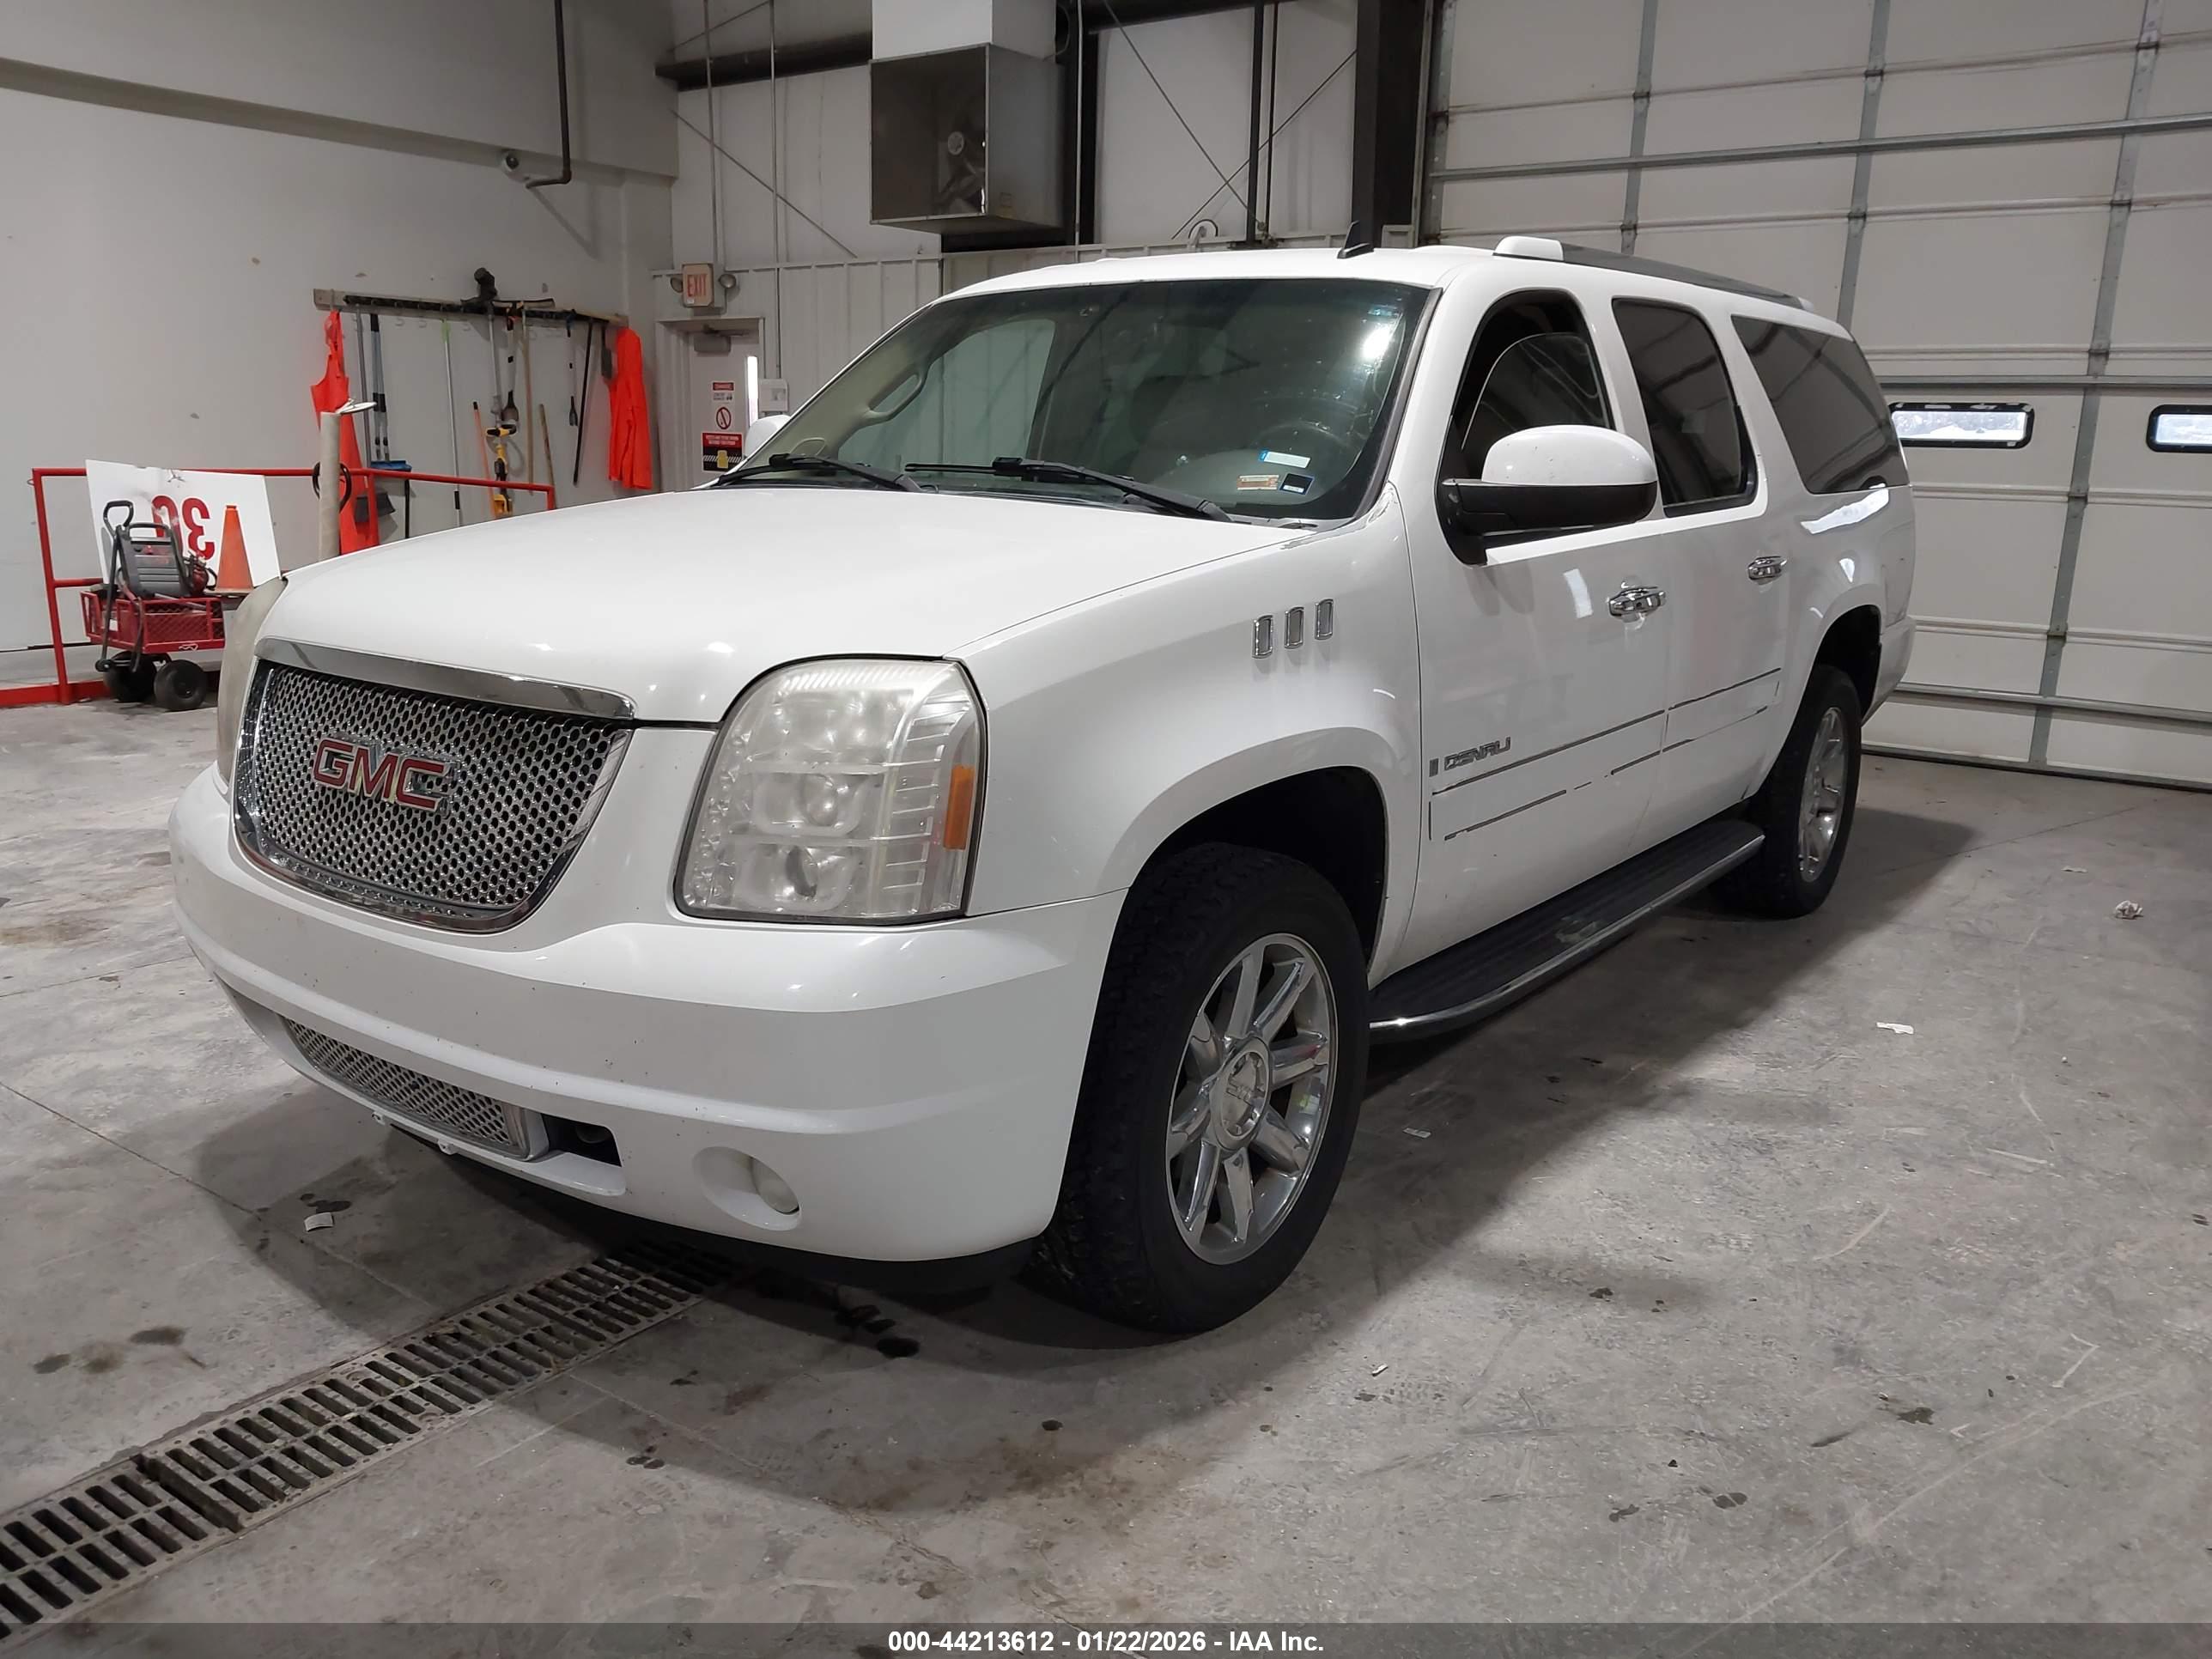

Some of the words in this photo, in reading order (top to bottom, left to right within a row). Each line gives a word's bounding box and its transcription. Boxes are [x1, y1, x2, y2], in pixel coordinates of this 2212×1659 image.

[686, 273, 708, 297] EXIT
[1443, 736, 1511, 771] DENALI
[313, 737, 449, 812] GMC
